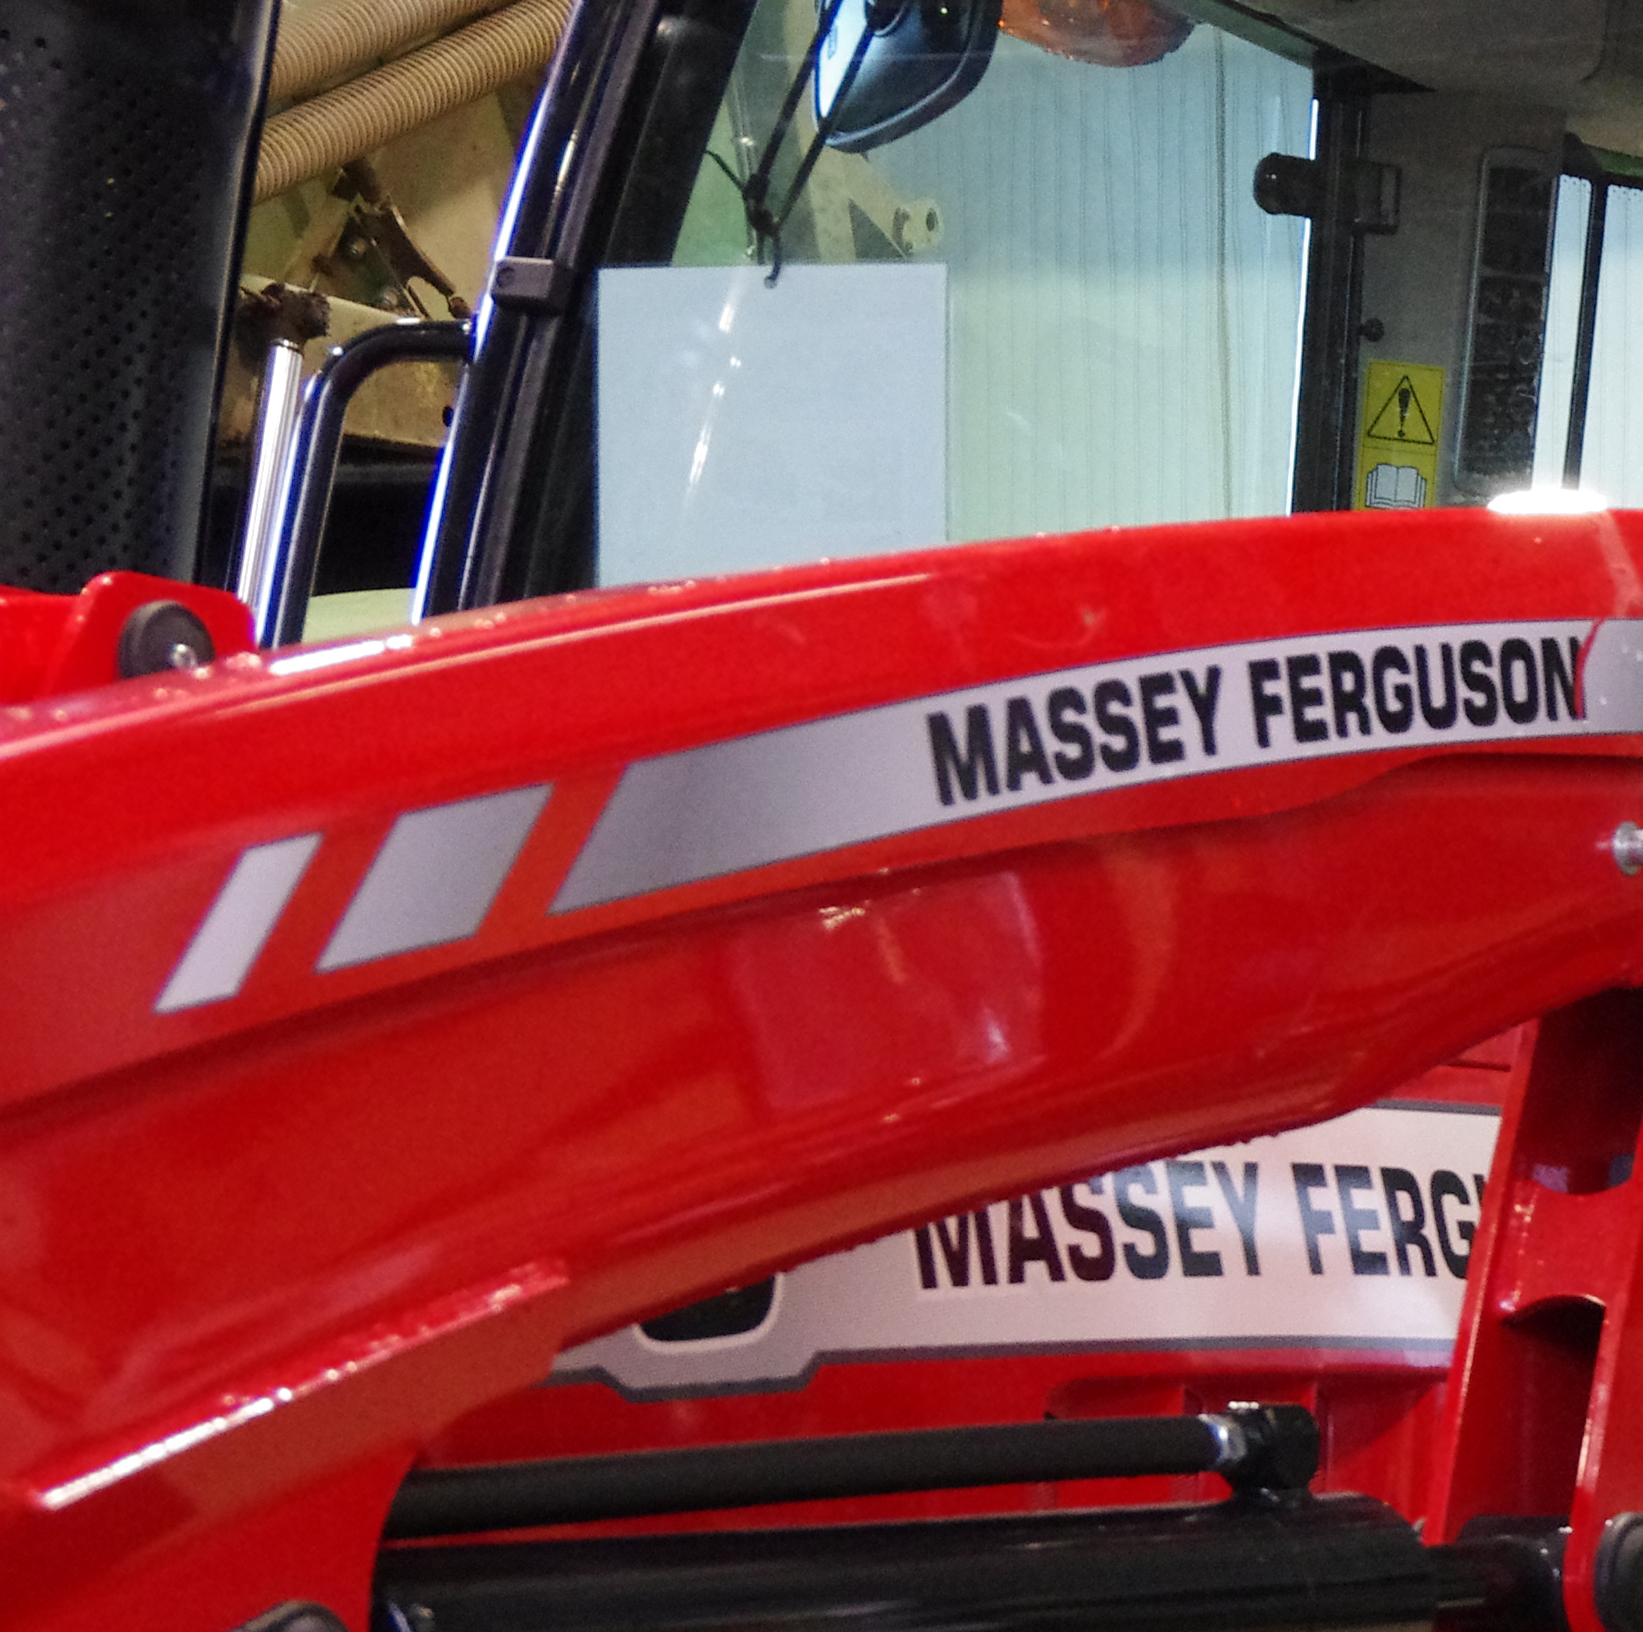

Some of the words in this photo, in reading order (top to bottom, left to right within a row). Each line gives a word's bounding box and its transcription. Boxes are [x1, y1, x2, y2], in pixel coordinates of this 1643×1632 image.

[927, 665, 1222, 806] MASSEY
[1249, 636, 1585, 749] FERGUSON
[914, 1160, 1260, 1290] MASSEY
[1290, 1162, 1488, 1280] FERG
